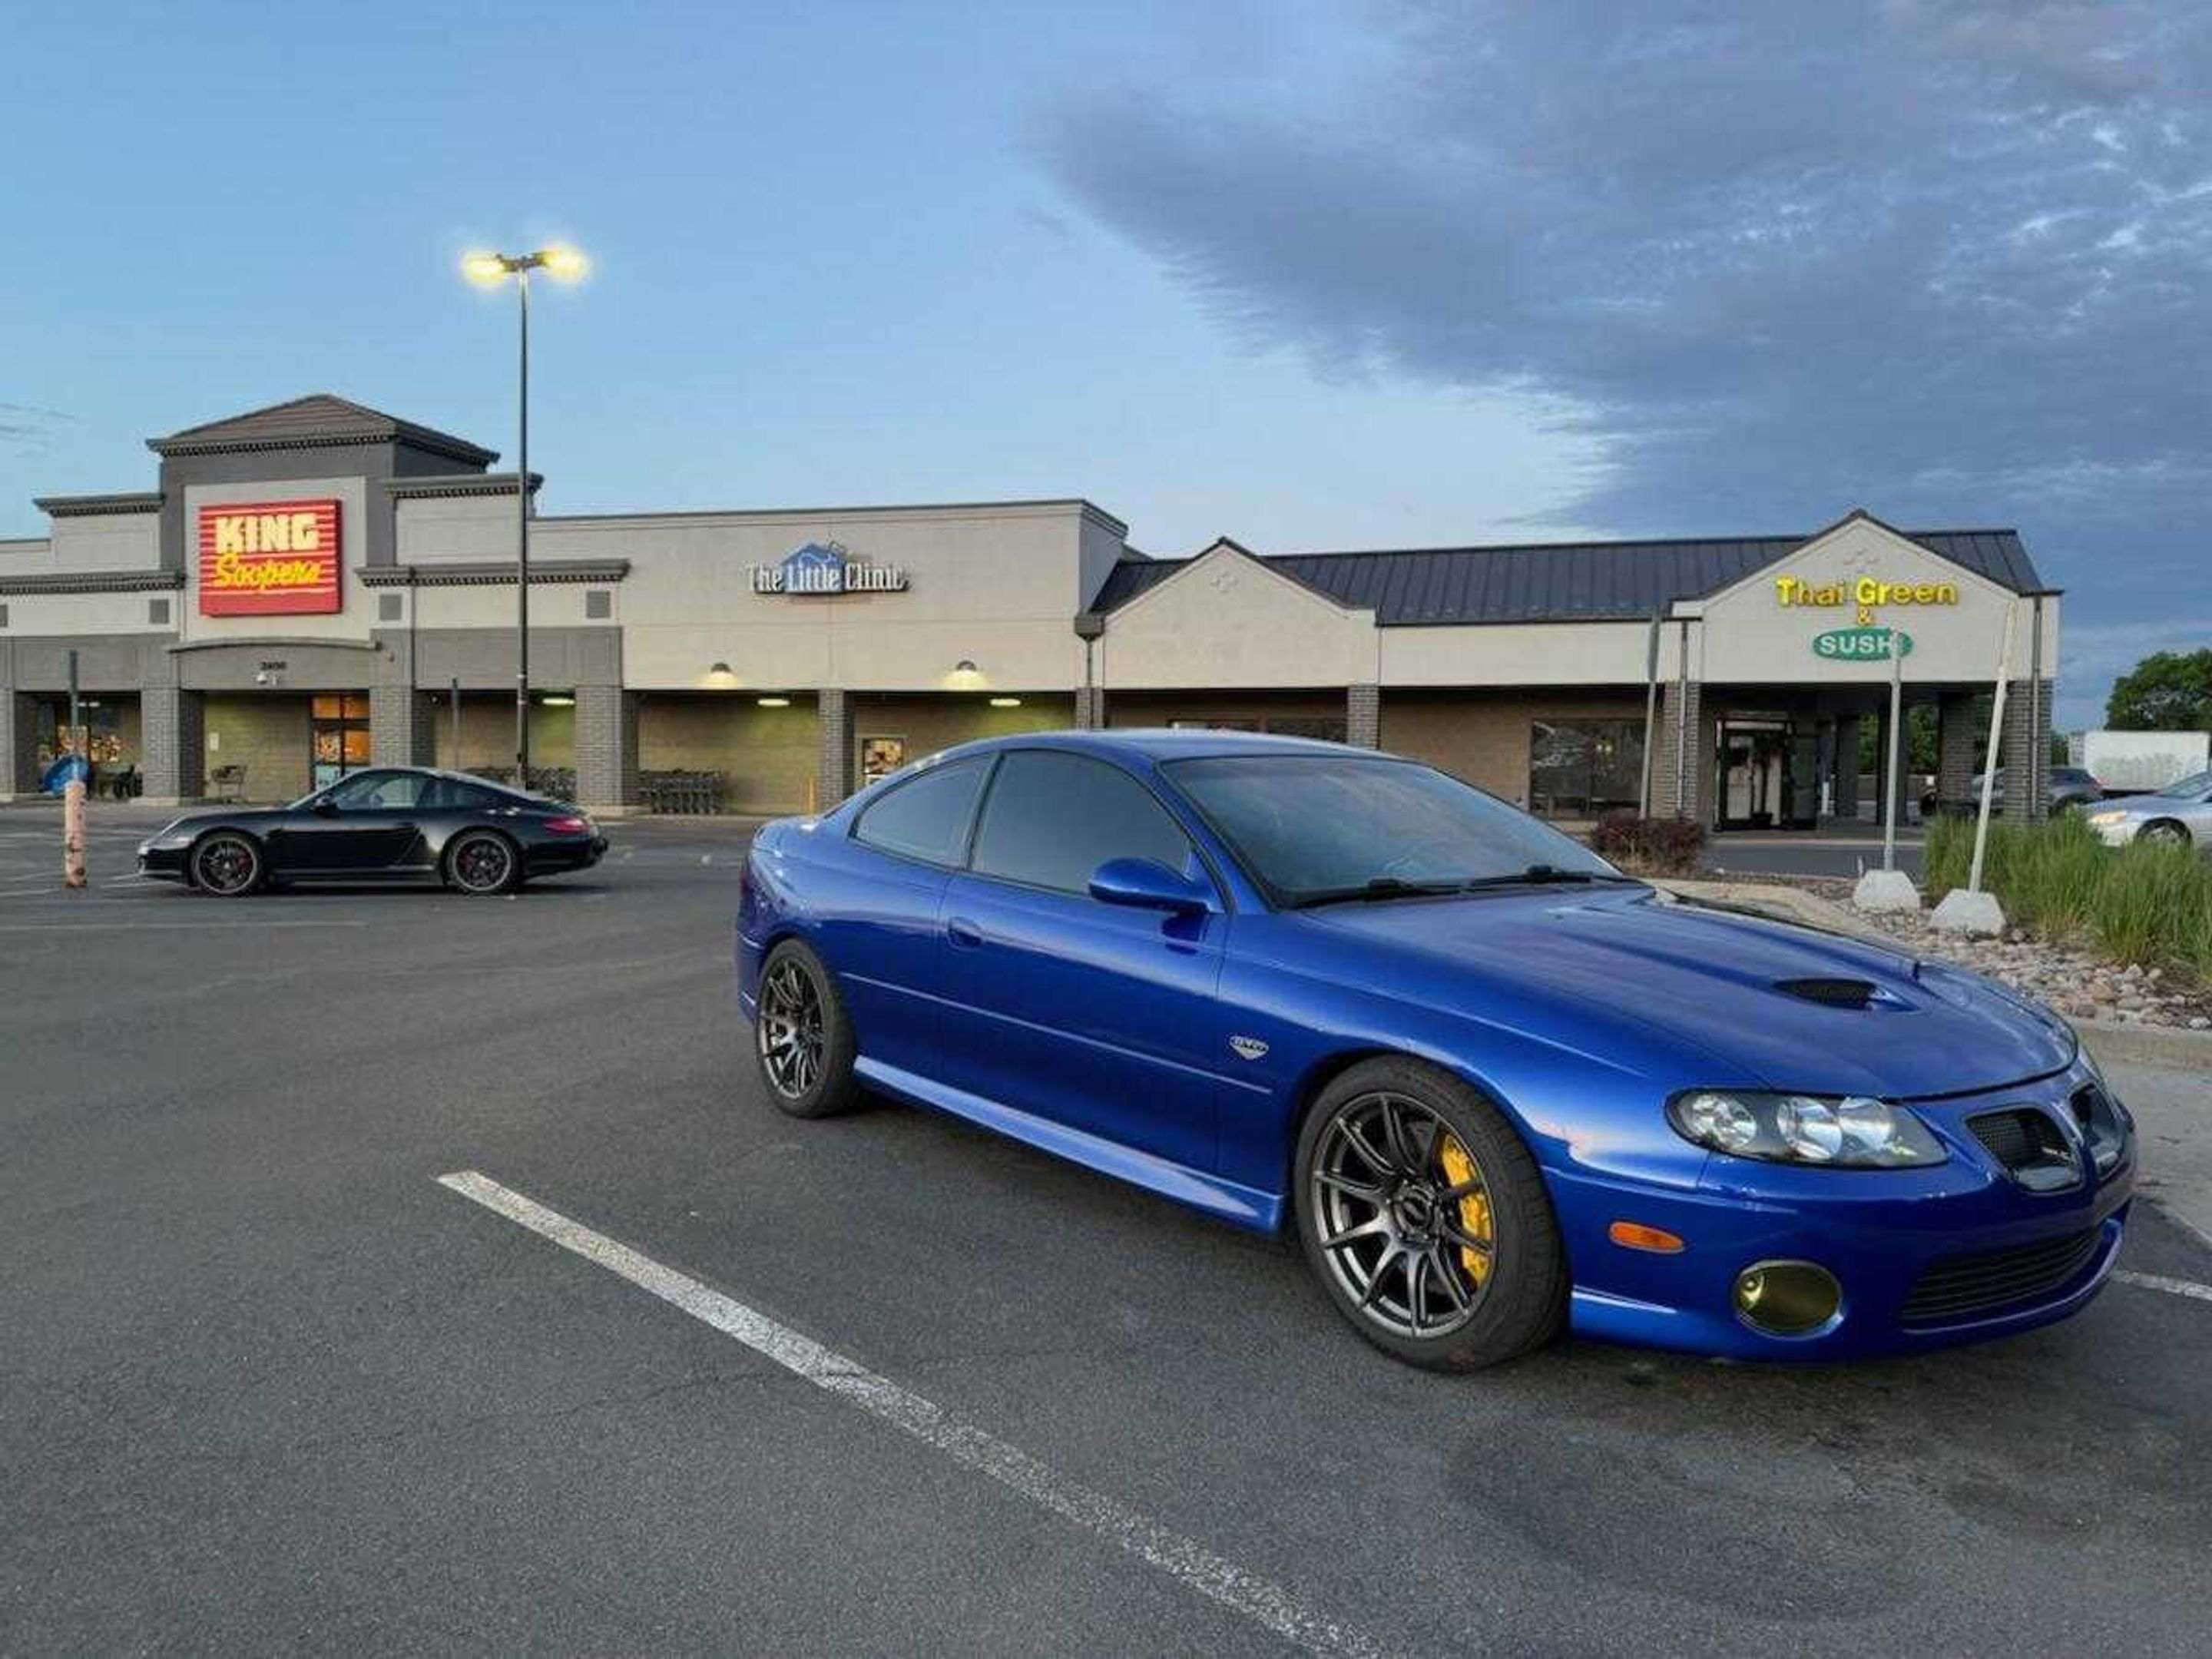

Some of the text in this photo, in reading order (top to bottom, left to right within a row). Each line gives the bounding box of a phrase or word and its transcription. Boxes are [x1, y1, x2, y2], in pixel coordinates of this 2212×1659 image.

[216, 513, 320, 554] KING
[747, 562, 906, 591] The Little Clinic
[1776, 576, 1955, 607] Thai Green
[1858, 607, 1873, 624] &
[1820, 634, 1902, 654] SUSH
